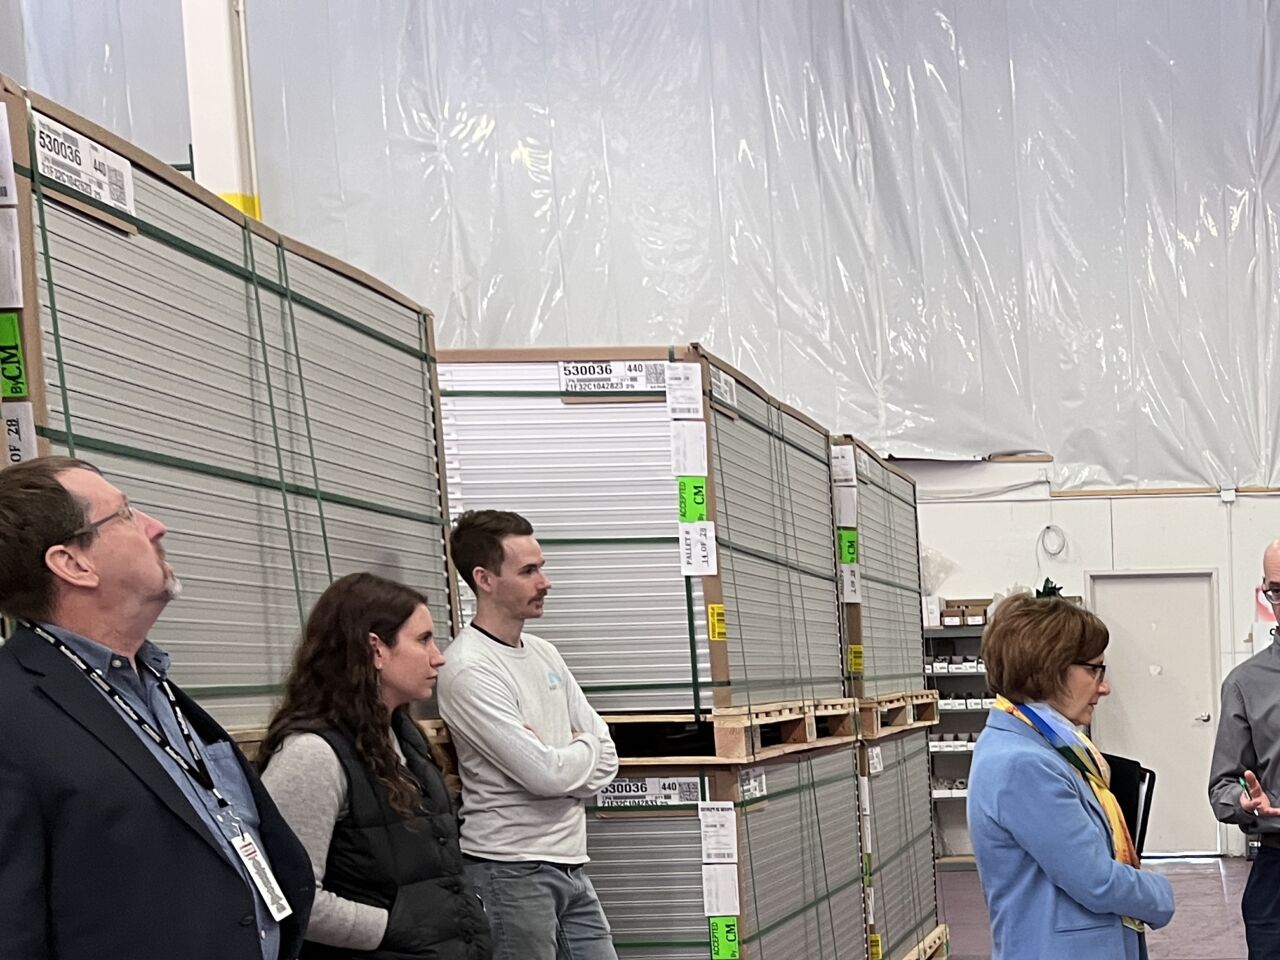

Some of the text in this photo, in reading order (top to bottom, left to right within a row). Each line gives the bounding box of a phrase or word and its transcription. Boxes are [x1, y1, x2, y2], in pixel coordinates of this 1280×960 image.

[39, 131, 82, 166] 530036
[1, 343, 23, 381] CM
[563, 364, 613, 376] 530036
[626, 363, 643, 373] 440
[9, 445, 22, 463] OF
[679, 481, 688, 518] ACCEPTED
[692, 485, 705, 505] CM
[685, 537, 693, 566] PALLET
[699, 542, 707, 552] OF
[847, 540, 856, 555] CM
[661, 782, 677, 791] 440
[711, 922, 720, 956] ACCEPTED
[725, 923, 737, 943] CM
